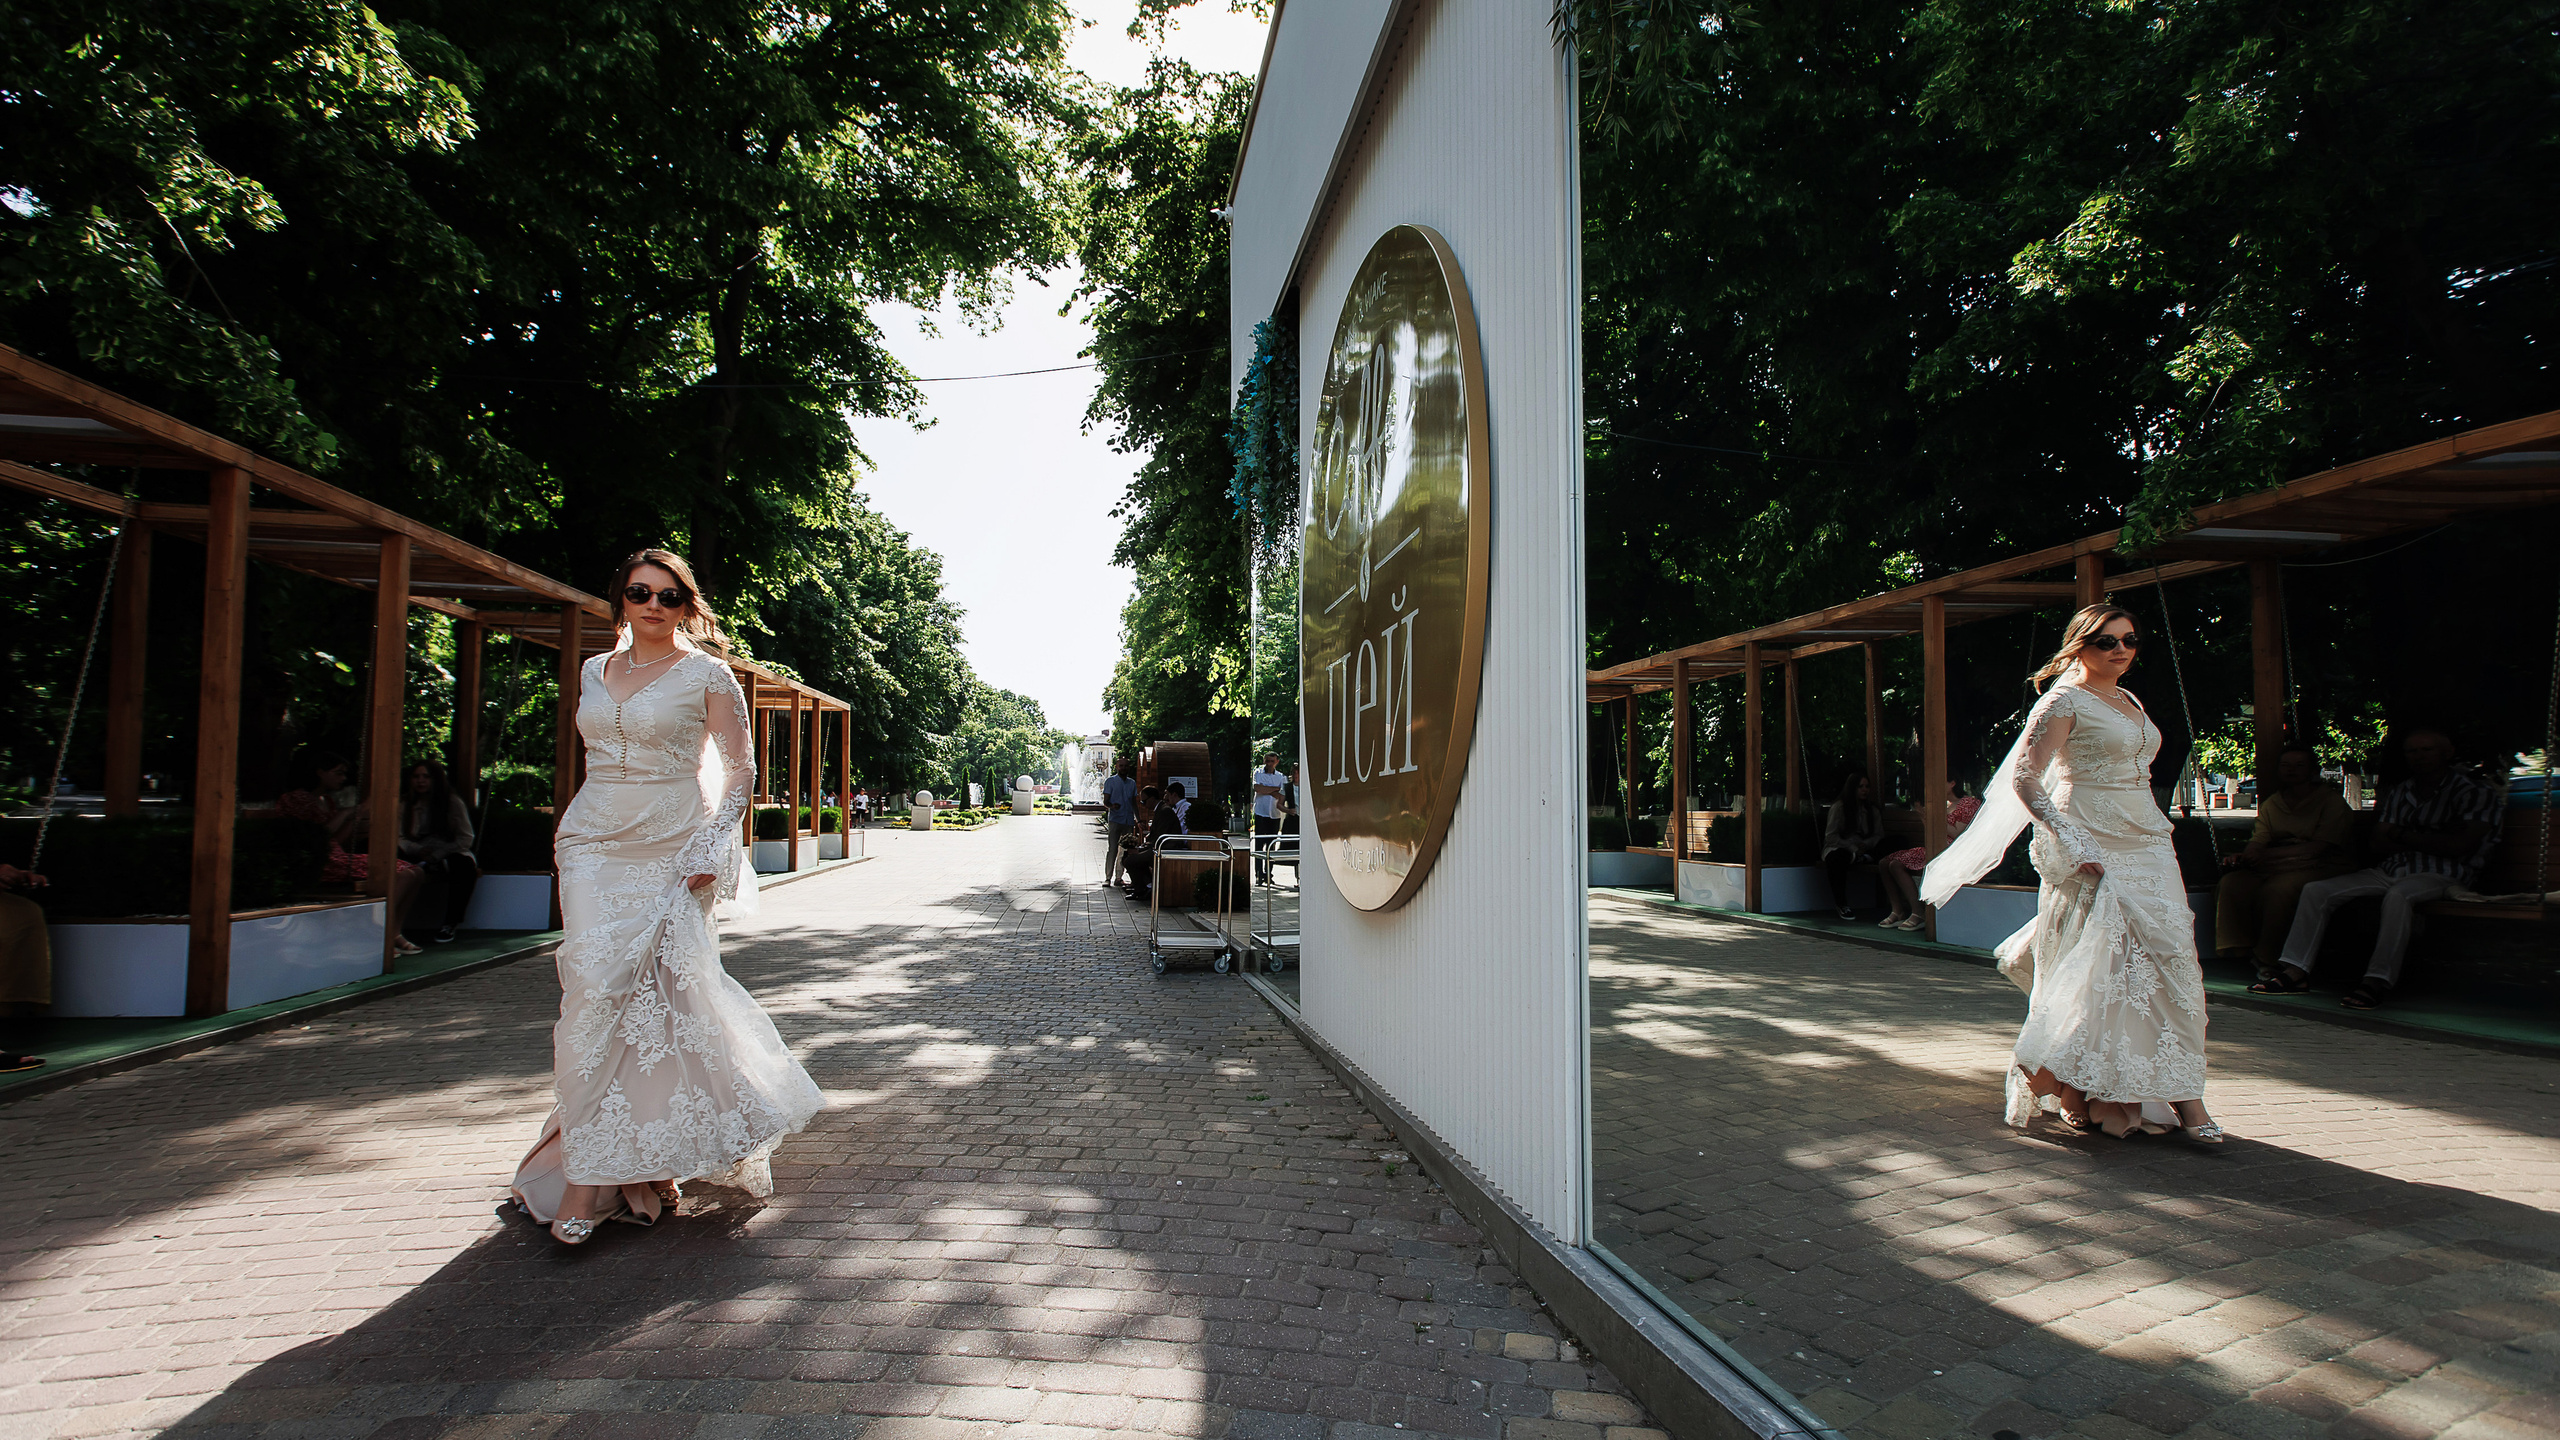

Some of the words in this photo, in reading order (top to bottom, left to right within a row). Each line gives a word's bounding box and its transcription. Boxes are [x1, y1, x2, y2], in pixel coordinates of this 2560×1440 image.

[1365, 271, 1388, 313] WAKE
[1324, 584, 1419, 787] пей
[1342, 839, 1363, 873] SINCE
[1366, 840, 1386, 873] 2016
